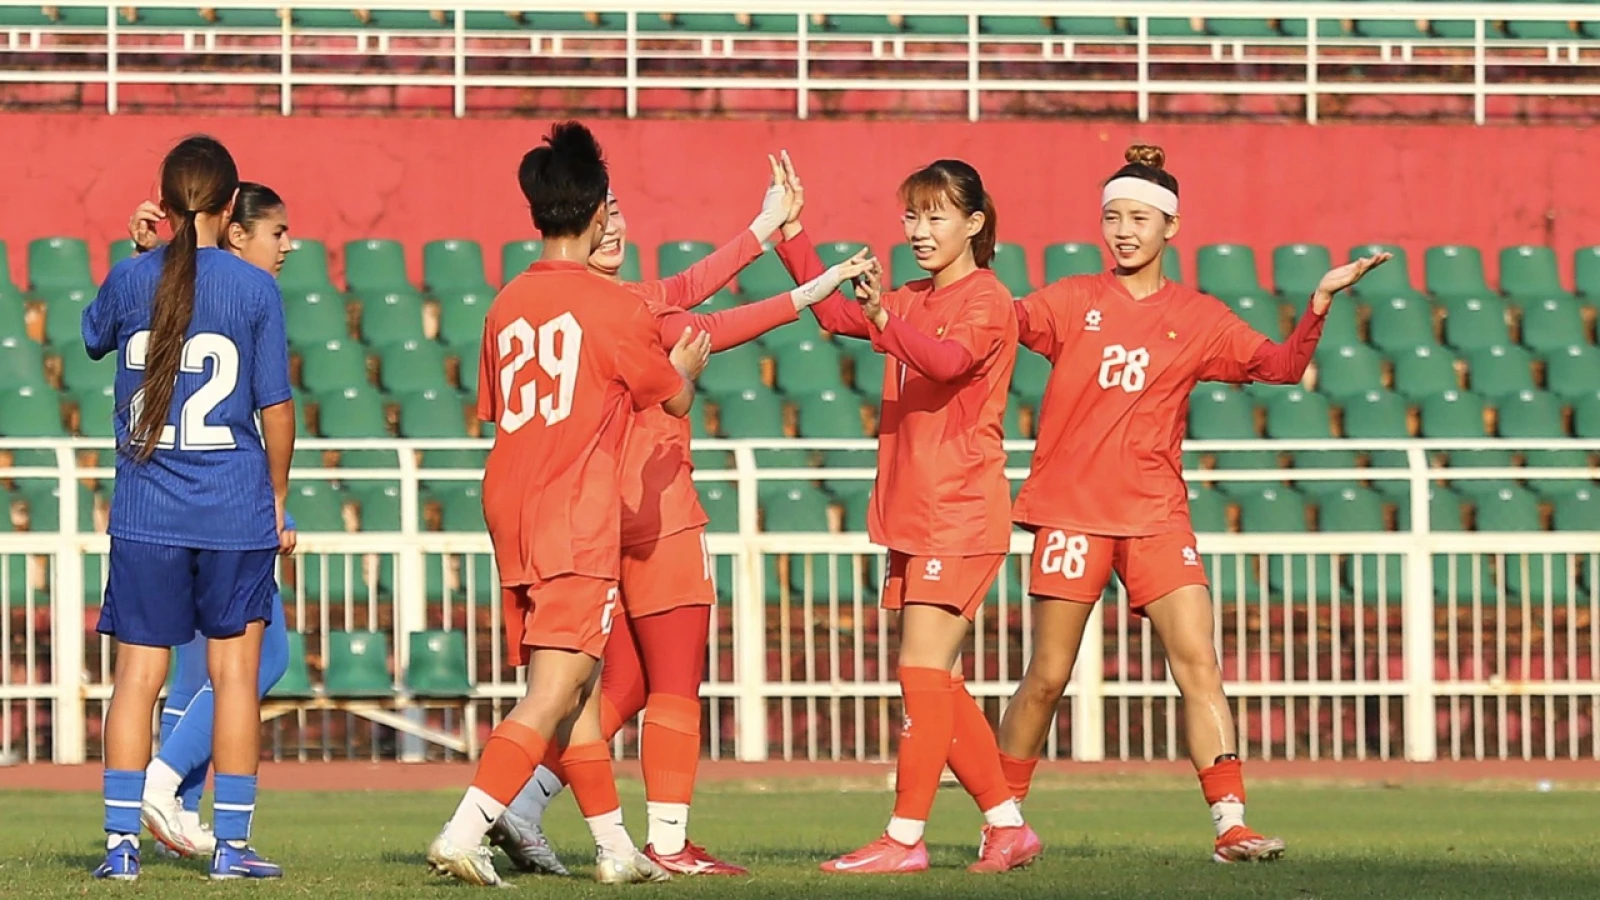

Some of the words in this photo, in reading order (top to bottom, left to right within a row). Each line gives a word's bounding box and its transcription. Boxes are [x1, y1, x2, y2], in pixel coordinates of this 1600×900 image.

[498, 311, 583, 434] 29
[1098, 344, 1150, 393] 28
[1041, 529, 1089, 580] 28
